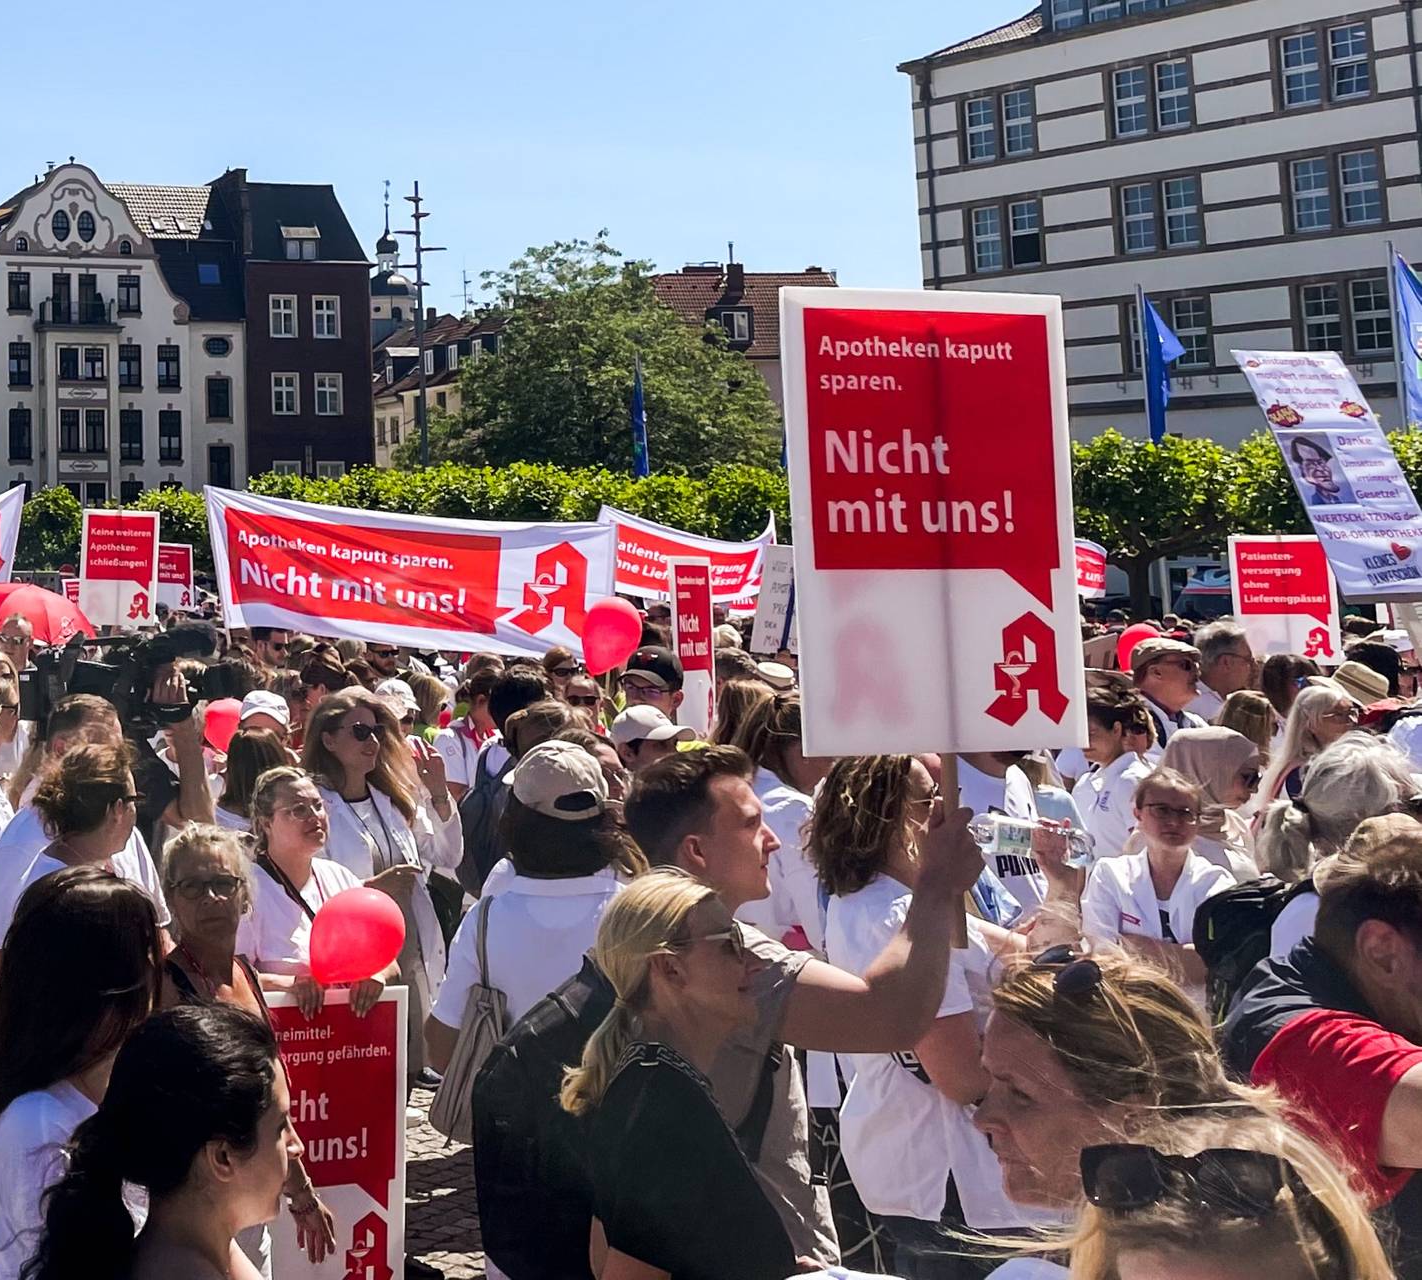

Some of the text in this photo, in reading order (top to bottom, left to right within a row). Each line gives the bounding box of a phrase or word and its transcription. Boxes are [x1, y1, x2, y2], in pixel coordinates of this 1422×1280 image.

[818, 335, 1014, 364] Apotheken kaputt
[819, 372, 904, 393] sparen.
[824, 427, 951, 475] Nicht
[827, 488, 1016, 534] mit uns!
[237, 529, 455, 571] Apotheken kaputt sparen.
[1240, 551, 1295, 562] Patienten-
[1241, 565, 1302, 577] versorgung
[239, 558, 466, 615] Nicht mit uns!
[1242, 579, 1270, 590] ohne
[1243, 592, 1327, 605] Lieferengpässe!
[275, 1025, 335, 1042] neimittel-
[327, 1043, 392, 1065] gefährden.
[307, 1127, 368, 1163] uns!
